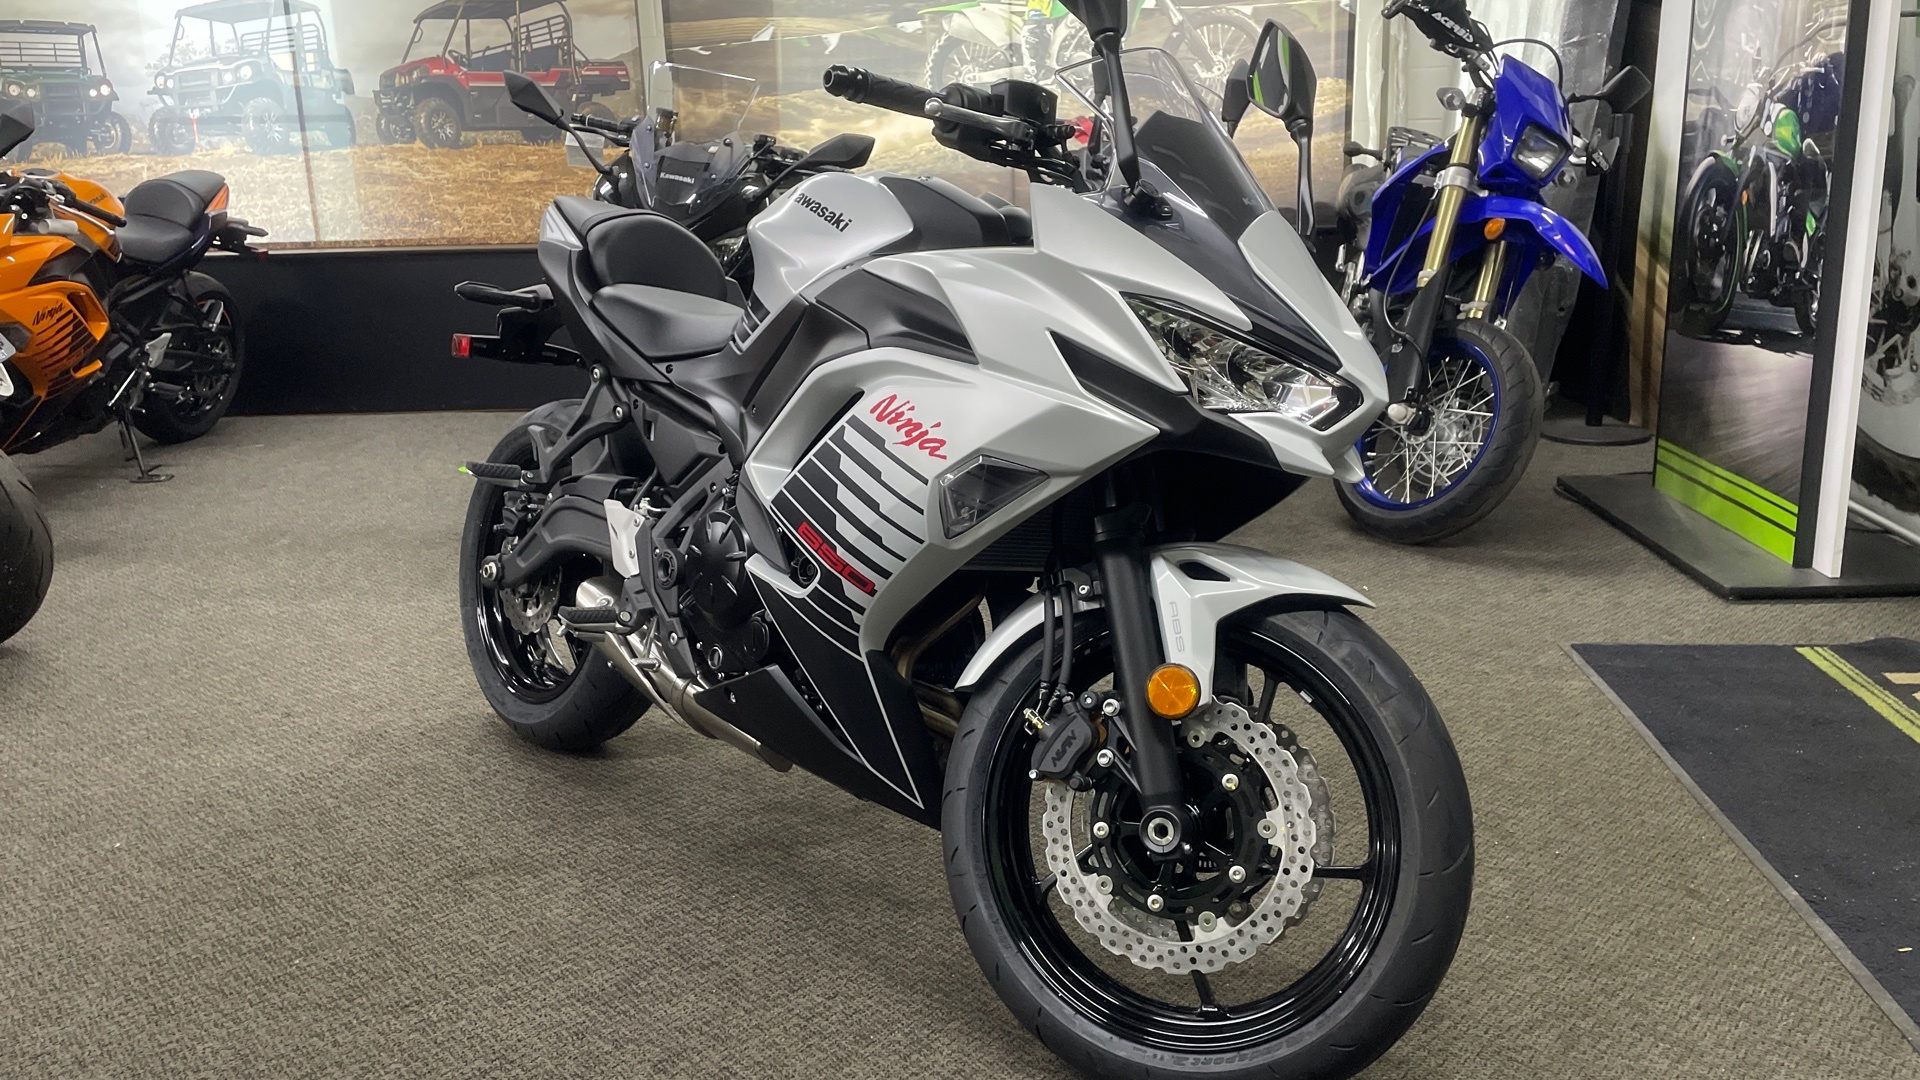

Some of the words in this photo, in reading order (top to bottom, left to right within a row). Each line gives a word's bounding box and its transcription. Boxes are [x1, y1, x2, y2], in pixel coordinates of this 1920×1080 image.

[659, 171, 695, 184] Kawasaki
[32, 300, 65, 326] Ninja
[869, 393, 948, 460] Ninja
[797, 521, 877, 595] 650
[1169, 601, 1185, 652] ABS
